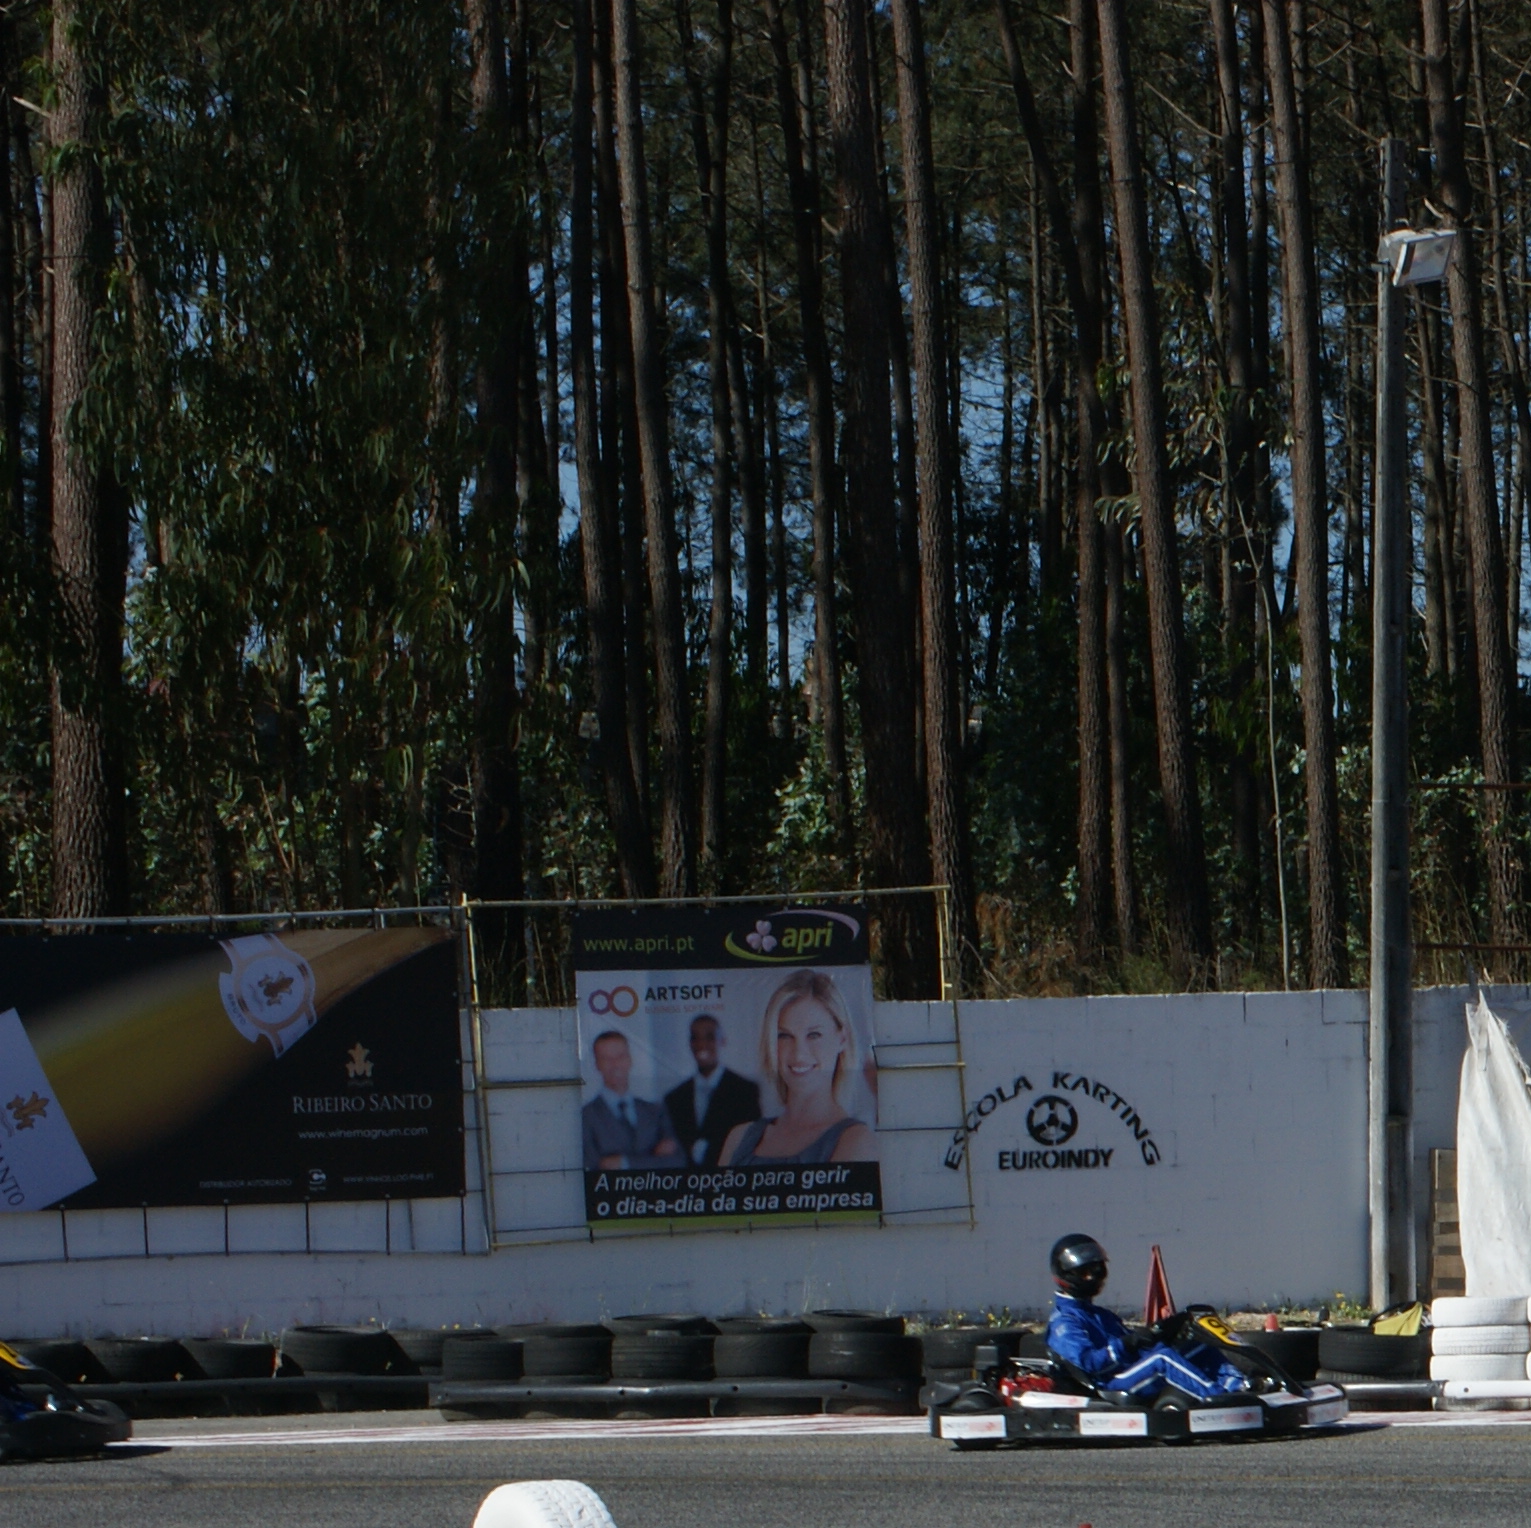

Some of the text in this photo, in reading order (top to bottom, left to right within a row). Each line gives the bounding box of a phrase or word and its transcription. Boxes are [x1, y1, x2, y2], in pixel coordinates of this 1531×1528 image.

[583, 921, 834, 956] www.apri.pt apri
[644, 983, 725, 1001] ARTSOFT
[292, 1093, 433, 1113] RIBEIRO SANTO
[1053, 1071, 1161, 1166] KARTING
[998, 1148, 1115, 1170] EUROINDY
[594, 1165, 850, 1193] A melhor opção para gerir
[597, 1190, 874, 1217] o dia-a-dia da sua empresa
